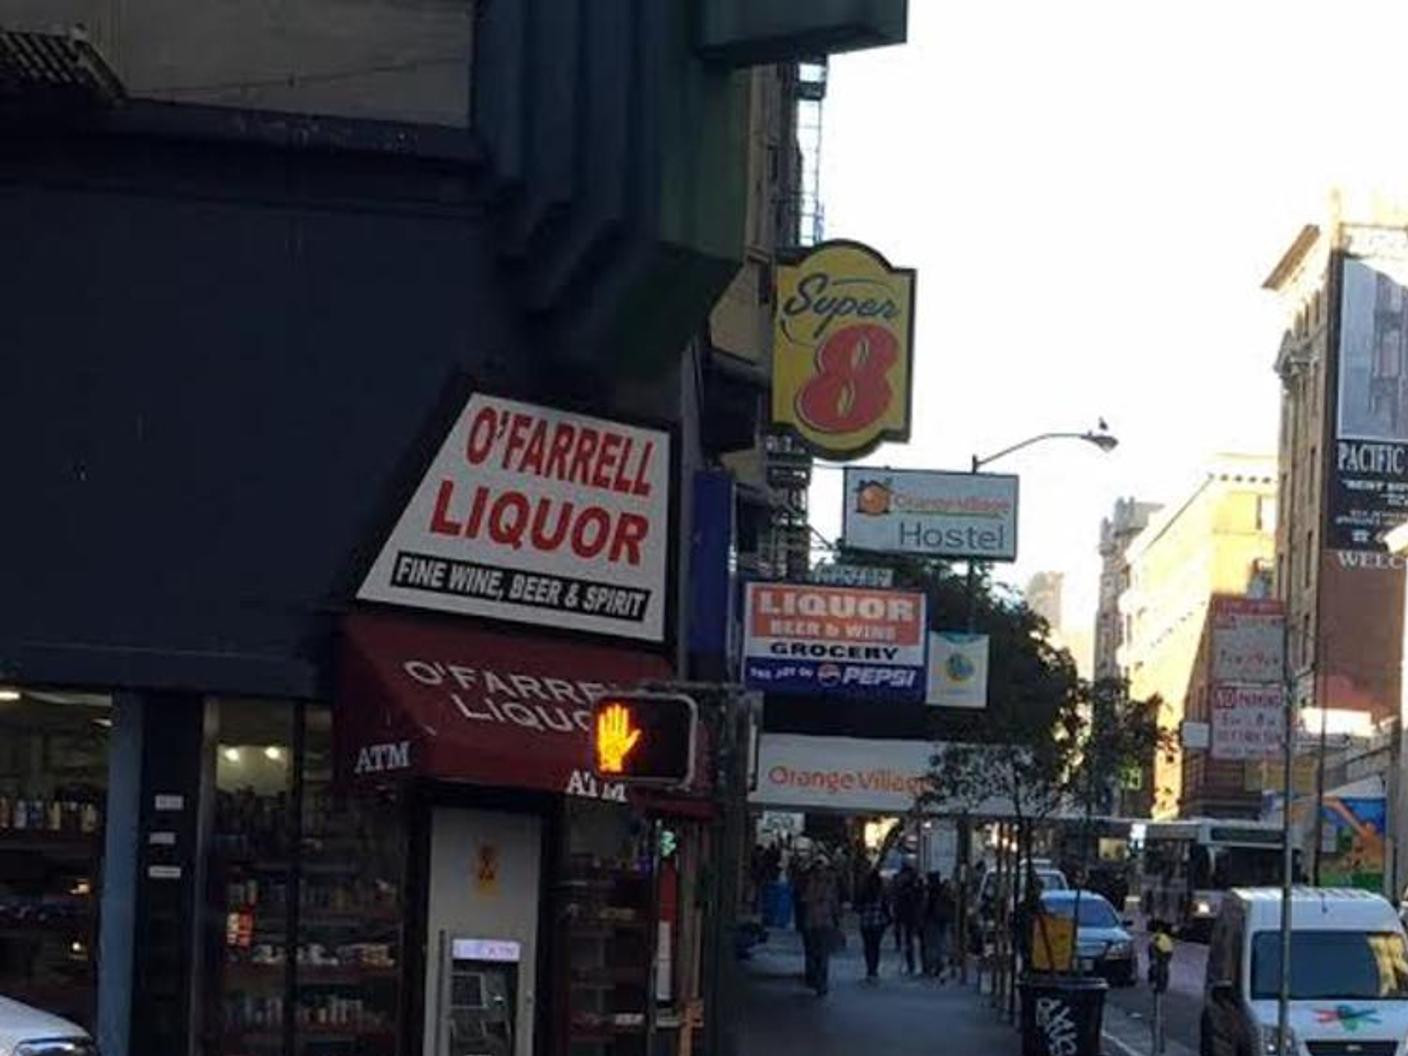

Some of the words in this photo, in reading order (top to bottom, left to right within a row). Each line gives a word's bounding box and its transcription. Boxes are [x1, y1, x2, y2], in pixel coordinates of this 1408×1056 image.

[783, 273, 899, 339] Super
[794, 322, 899, 434] 8
[466, 405, 653, 497] O'FARRELL
[1337, 442, 1405, 475] PACIFIC
[430, 480, 650, 566] LIQUOR
[900, 521, 1005, 550] Hostel
[1338, 550, 1406, 569] WELC
[396, 557, 448, 587] FINE
[449, 562, 504, 597] WINE,
[509, 573, 560, 605] BEER
[564, 583, 580, 607] &
[584, 586, 646, 617] SPIRIT
[760, 590, 915, 621] LIQUOR
[770, 619, 821, 637] BEER
[845, 624, 897, 640] WINE
[770, 642, 899, 660] GROCERY
[404, 660, 608, 703] O'FARRE
[842, 666, 916, 688] PEPSI
[450, 693, 592, 732] LIQUO
[354, 742, 411, 774] ATM
[768, 765, 856, 793] Orange
